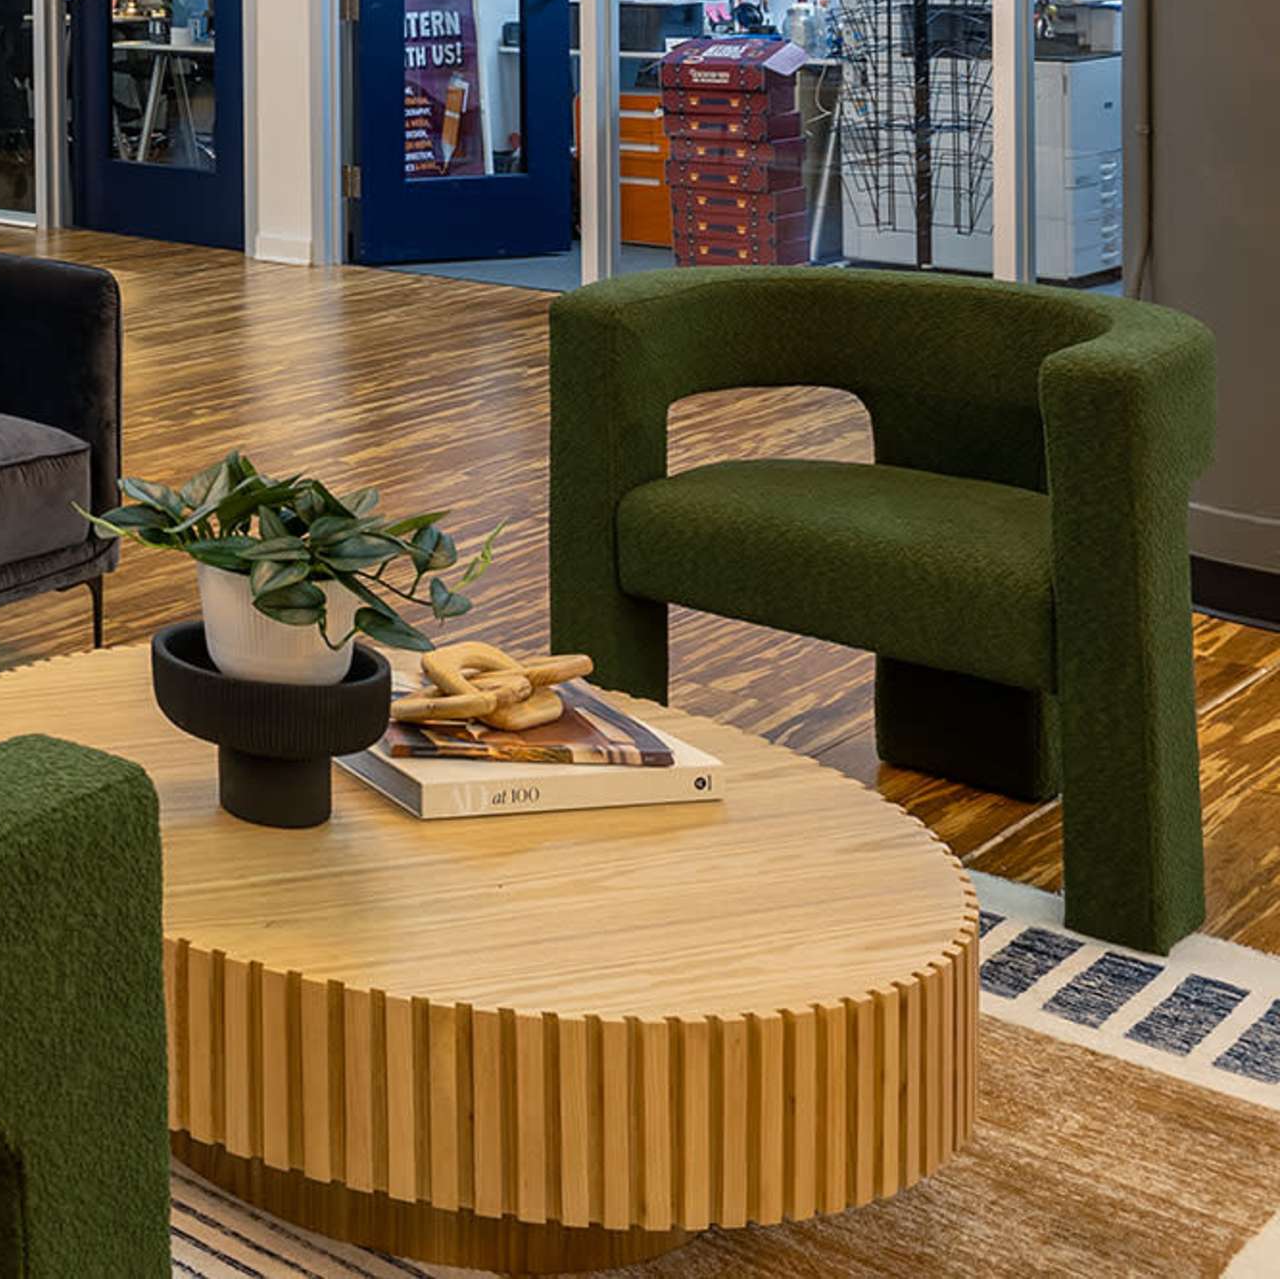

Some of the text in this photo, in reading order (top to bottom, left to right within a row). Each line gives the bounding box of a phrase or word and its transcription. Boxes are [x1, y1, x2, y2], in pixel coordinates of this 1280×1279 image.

[405, 42, 462, 68] TH US!
[492, 789, 507, 805] at
[511, 785, 540, 803] 100
